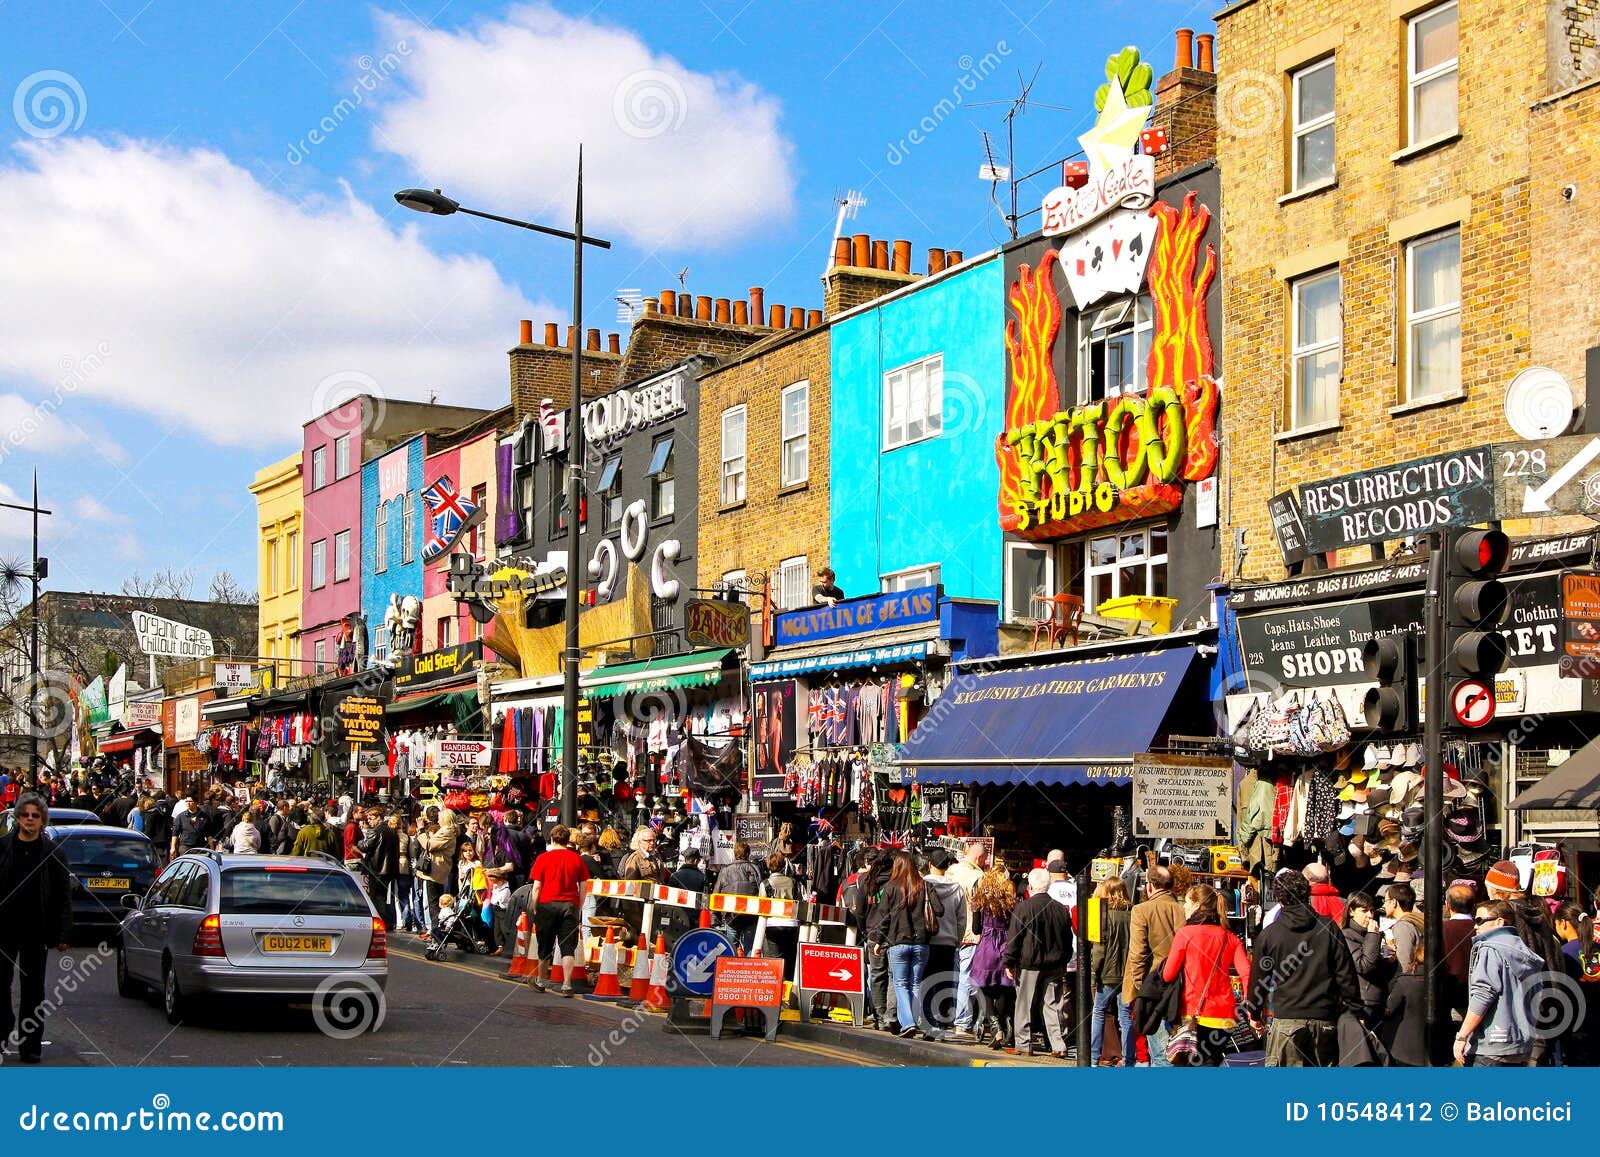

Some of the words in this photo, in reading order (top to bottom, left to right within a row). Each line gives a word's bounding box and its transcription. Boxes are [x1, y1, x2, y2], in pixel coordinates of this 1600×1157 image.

[1044, 190, 1081, 232] Evil
[1007, 385, 1185, 502] TATTOO
[1503, 448, 1547, 477] 228
[1304, 452, 1486, 516] RESURRECTION
[1014, 482, 1115, 531] STUDIO
[1341, 496, 1452, 543] RECORDS
[1528, 536, 1592, 558] JEWELLERY
[449, 567, 567, 598] Martens
[1231, 593, 1246, 603] 228
[1254, 584, 1291, 602] SMOKING
[1291, 584, 1311, 598] ACC.
[1317, 578, 1341, 594] BAGS
[1341, 577, 1348, 590] &
[1349, 569, 1391, 589] LUGGAGE
[1396, 564, 1421, 579] HATS
[781, 607, 854, 637] MOUNTAIN
[856, 602, 876, 626] OF
[879, 592, 933, 620] JEANS
[1514, 605, 1564, 623] Clothin
[1271, 639, 1296, 652] Jeans
[1304, 634, 1341, 648] Leather
[414, 655, 433, 675] Cold
[435, 648, 458, 670] Steel
[1249, 652, 1265, 665] 228
[626, 682, 644, 690] NEW
[647, 679, 669, 687] YORK
[953, 686, 1022, 704] EXCLUSIVE
[1022, 679, 1085, 698] LEATHER
[1086, 671, 1167, 693] GARMENTS
[340, 703, 383, 716] PIERCING
[343, 719, 380, 730] TATTOO
[443, 744, 480, 752] HANDBAGS
[449, 753, 477, 764] SALE
[904, 767, 917, 778] 230
[1086, 767, 1101, 778] 020
[1103, 766, 1122, 777] 7428
[1139, 767, 1191, 777] RESURRECTION
[1194, 769, 1227, 777] RECORDS
[1157, 778, 1196, 786] SPECIALISTS
[1182, 809, 1197, 817] RARE
[736, 820, 747, 829] HS
[750, 820, 766, 829] Hair
[1158, 821, 1205, 830] DOWNSTAIRS
[740, 830, 764, 838] Salon
[927, 828, 932, 837] I
[924, 838, 941, 848] Lond
[112, 878, 129, 888] JKK
[269, 937, 301, 949] GU02
[304, 937, 327, 949] CWR
[804, 949, 858, 960] PEDESTRIANS
